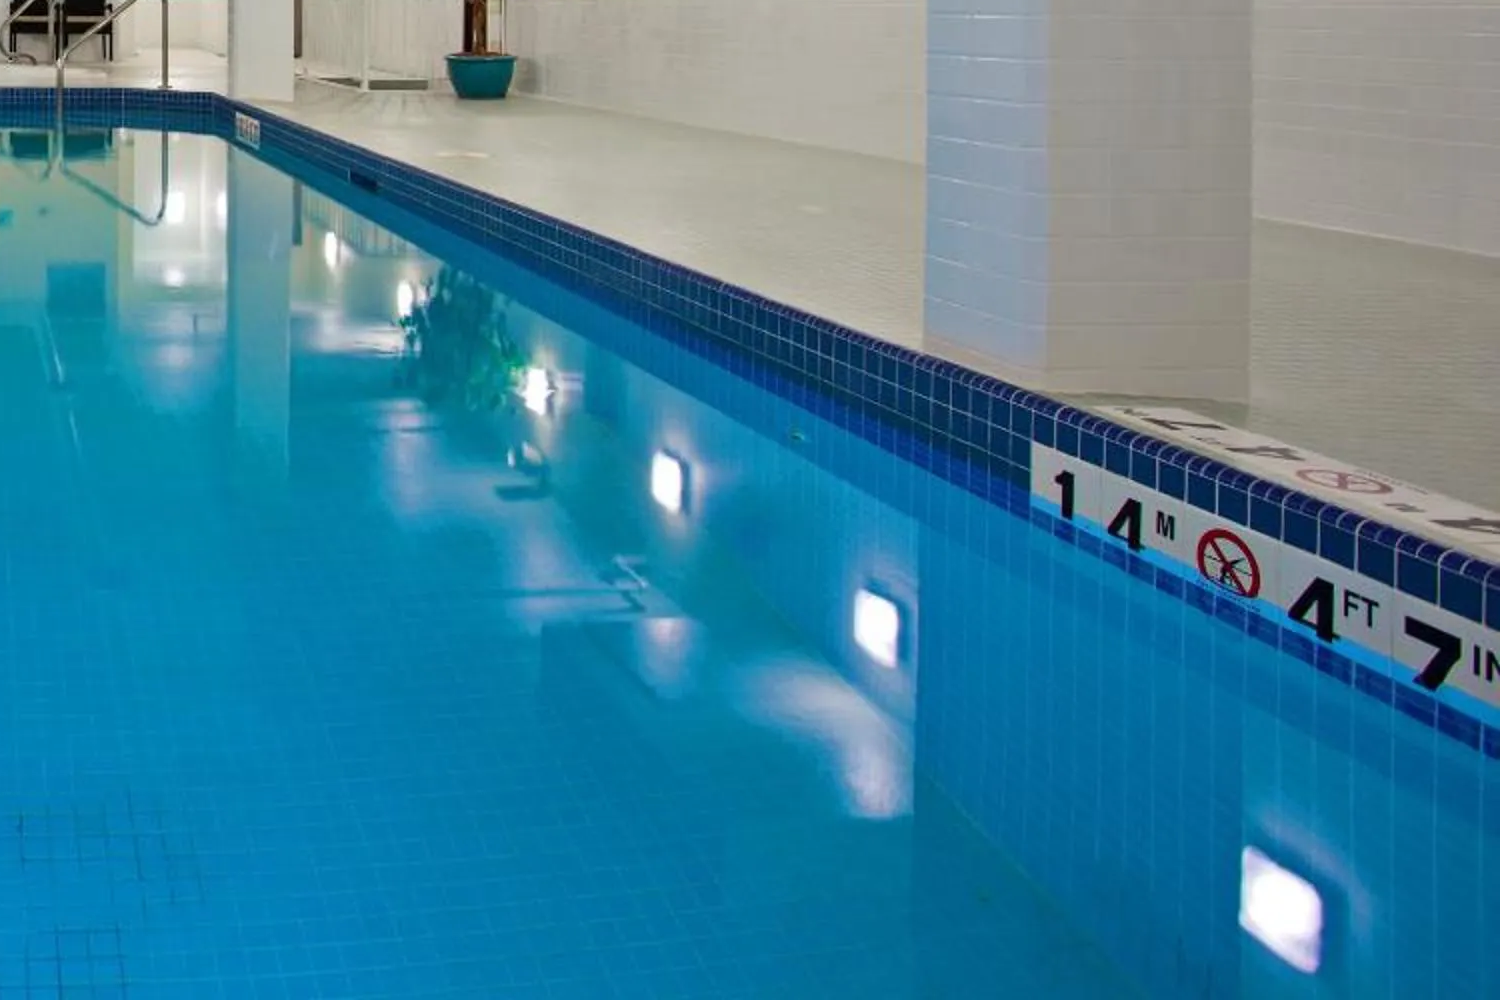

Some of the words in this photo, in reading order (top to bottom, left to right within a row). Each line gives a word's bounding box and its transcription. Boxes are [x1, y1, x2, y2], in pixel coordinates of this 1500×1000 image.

[1055, 470, 1074, 520] 1
[1107, 498, 1145, 552] 4
[1156, 510, 1175, 541] M
[1288, 576, 1341, 643] 4
[1344, 589, 1379, 628] FT
[1404, 615, 1462, 692] 7
